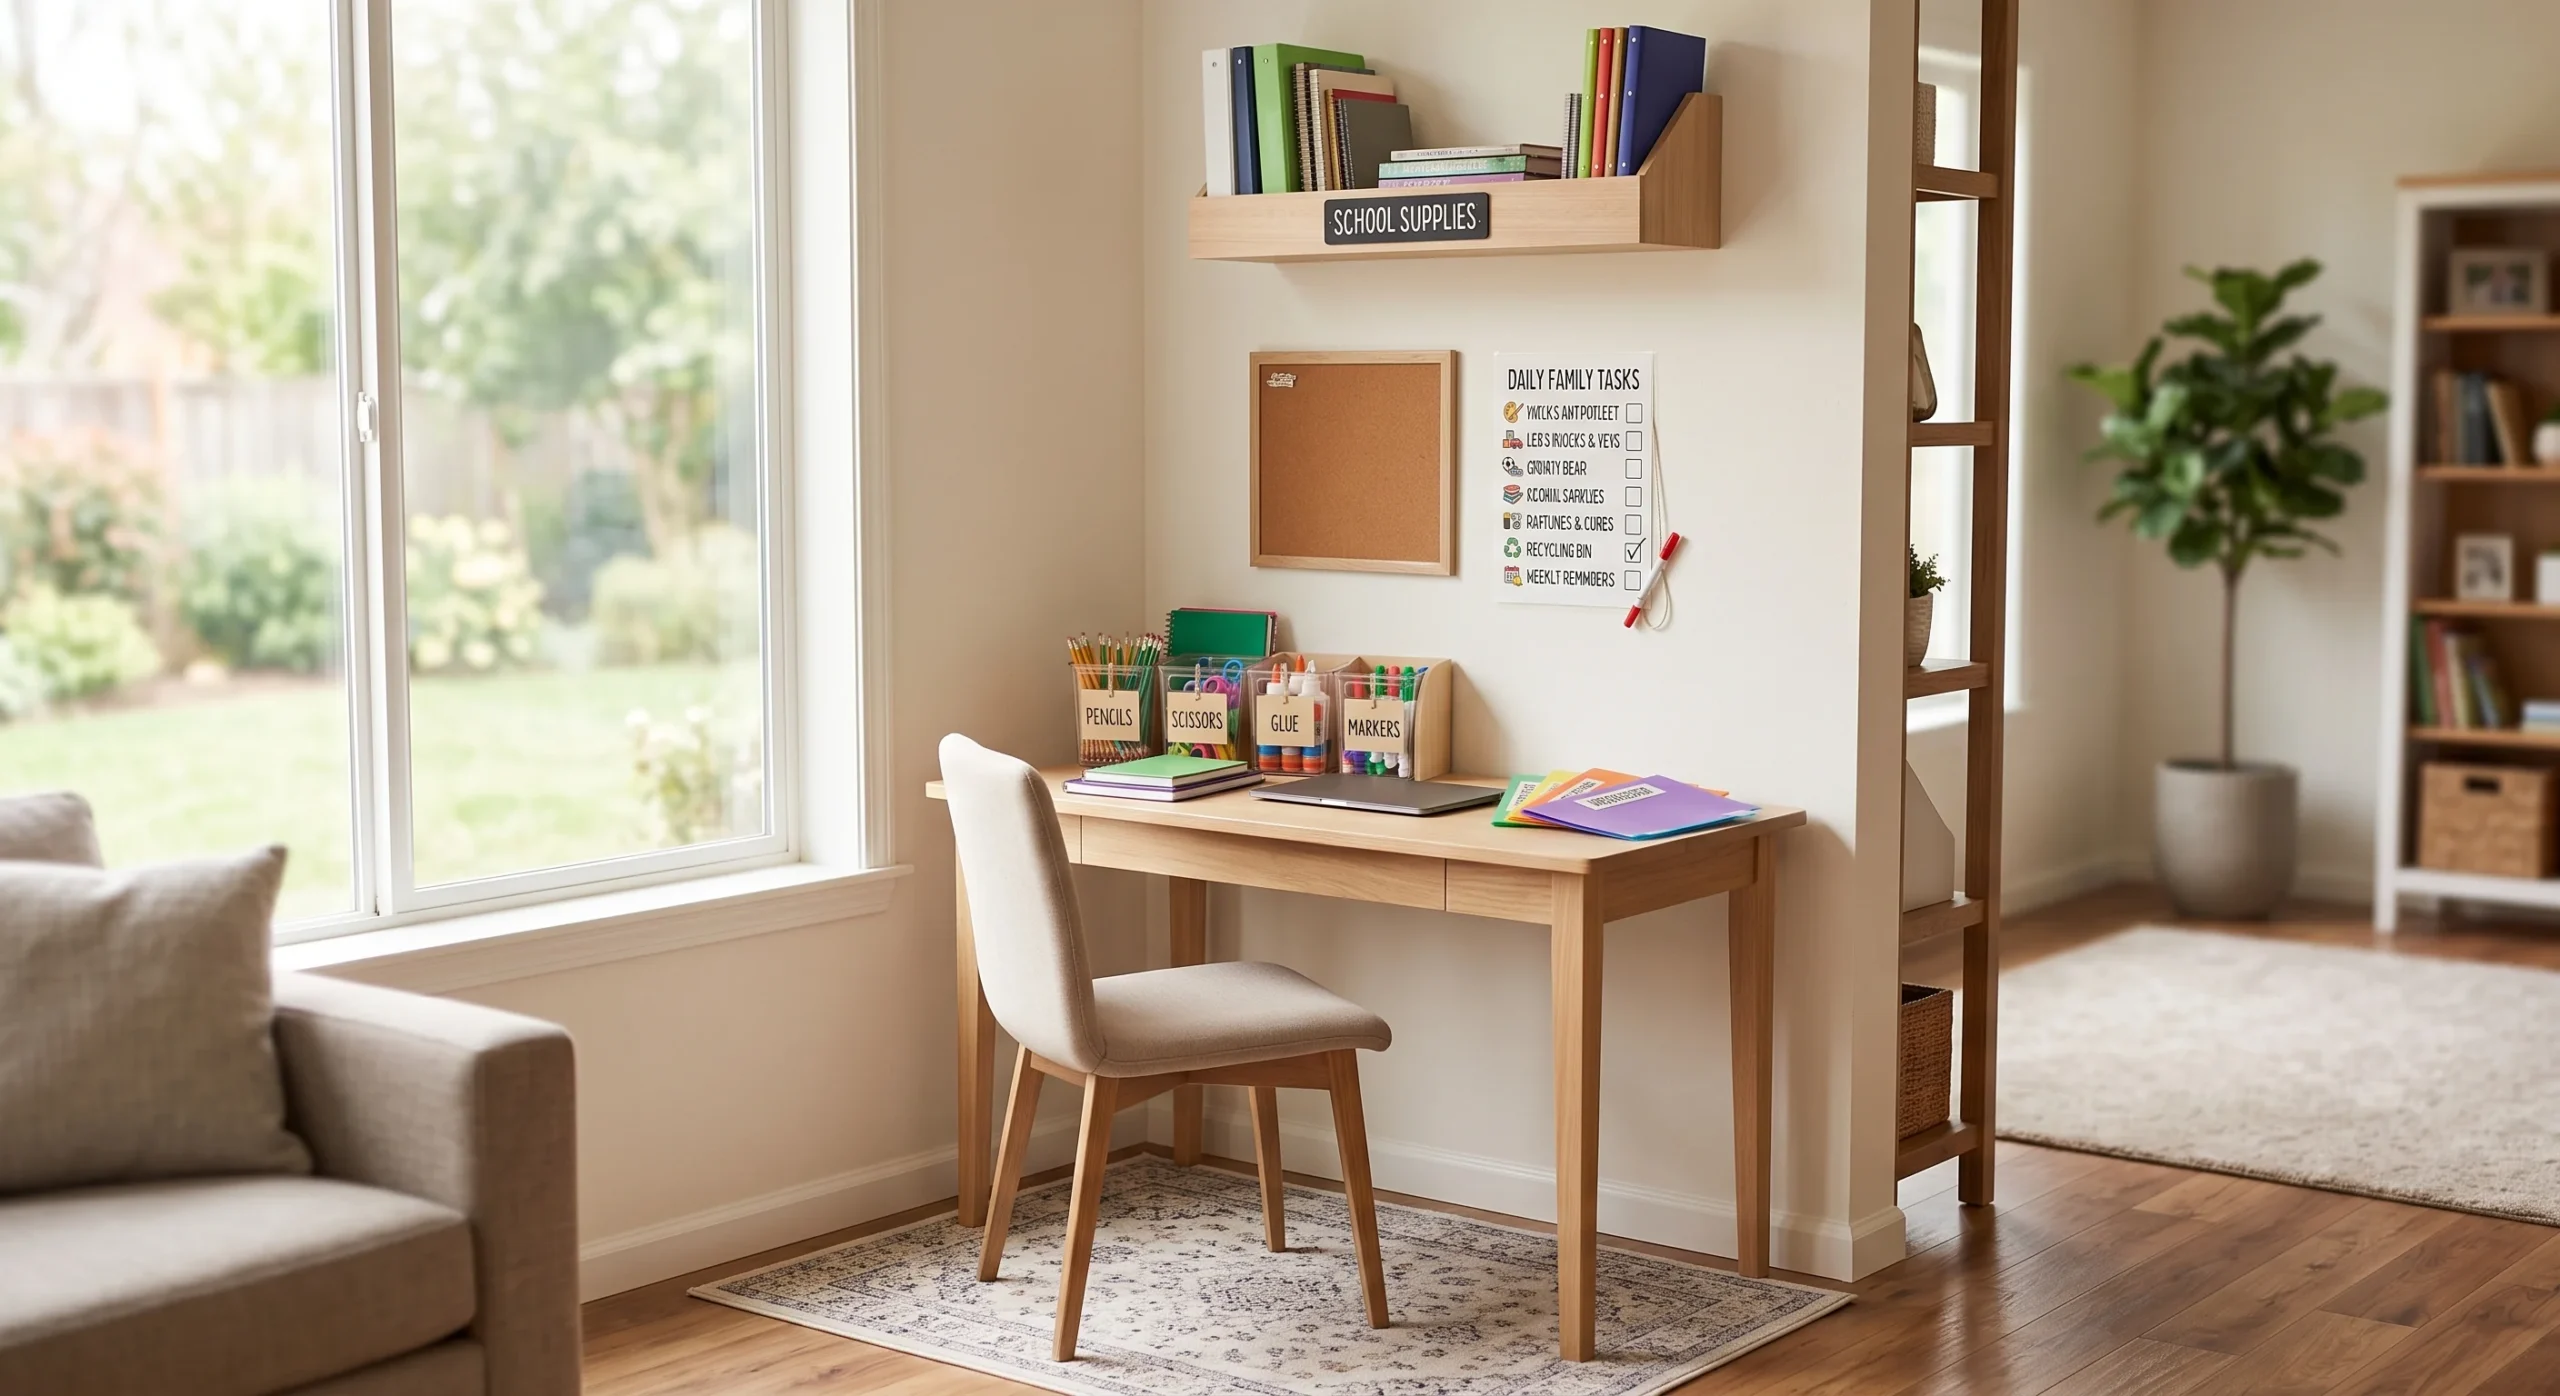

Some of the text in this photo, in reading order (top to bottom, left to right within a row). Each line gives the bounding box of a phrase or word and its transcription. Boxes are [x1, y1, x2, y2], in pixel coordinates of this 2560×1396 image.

[1333, 202, 1476, 236] SCHOOL SUPPLIES
[1508, 368, 1640, 390] DAILY FAMILY TASKS
[1587, 434, 1596, 448] &
[1563, 460, 1587, 476] BEAR
[1584, 516, 1614, 532] CURES
[1526, 542, 1592, 559] RECYCLING BIN
[1086, 707, 1133, 727] PENCILS
[1171, 710, 1223, 730] SCISSORS
[1270, 714, 1299, 733] GLUE
[1348, 718, 1401, 739] MARKERS
